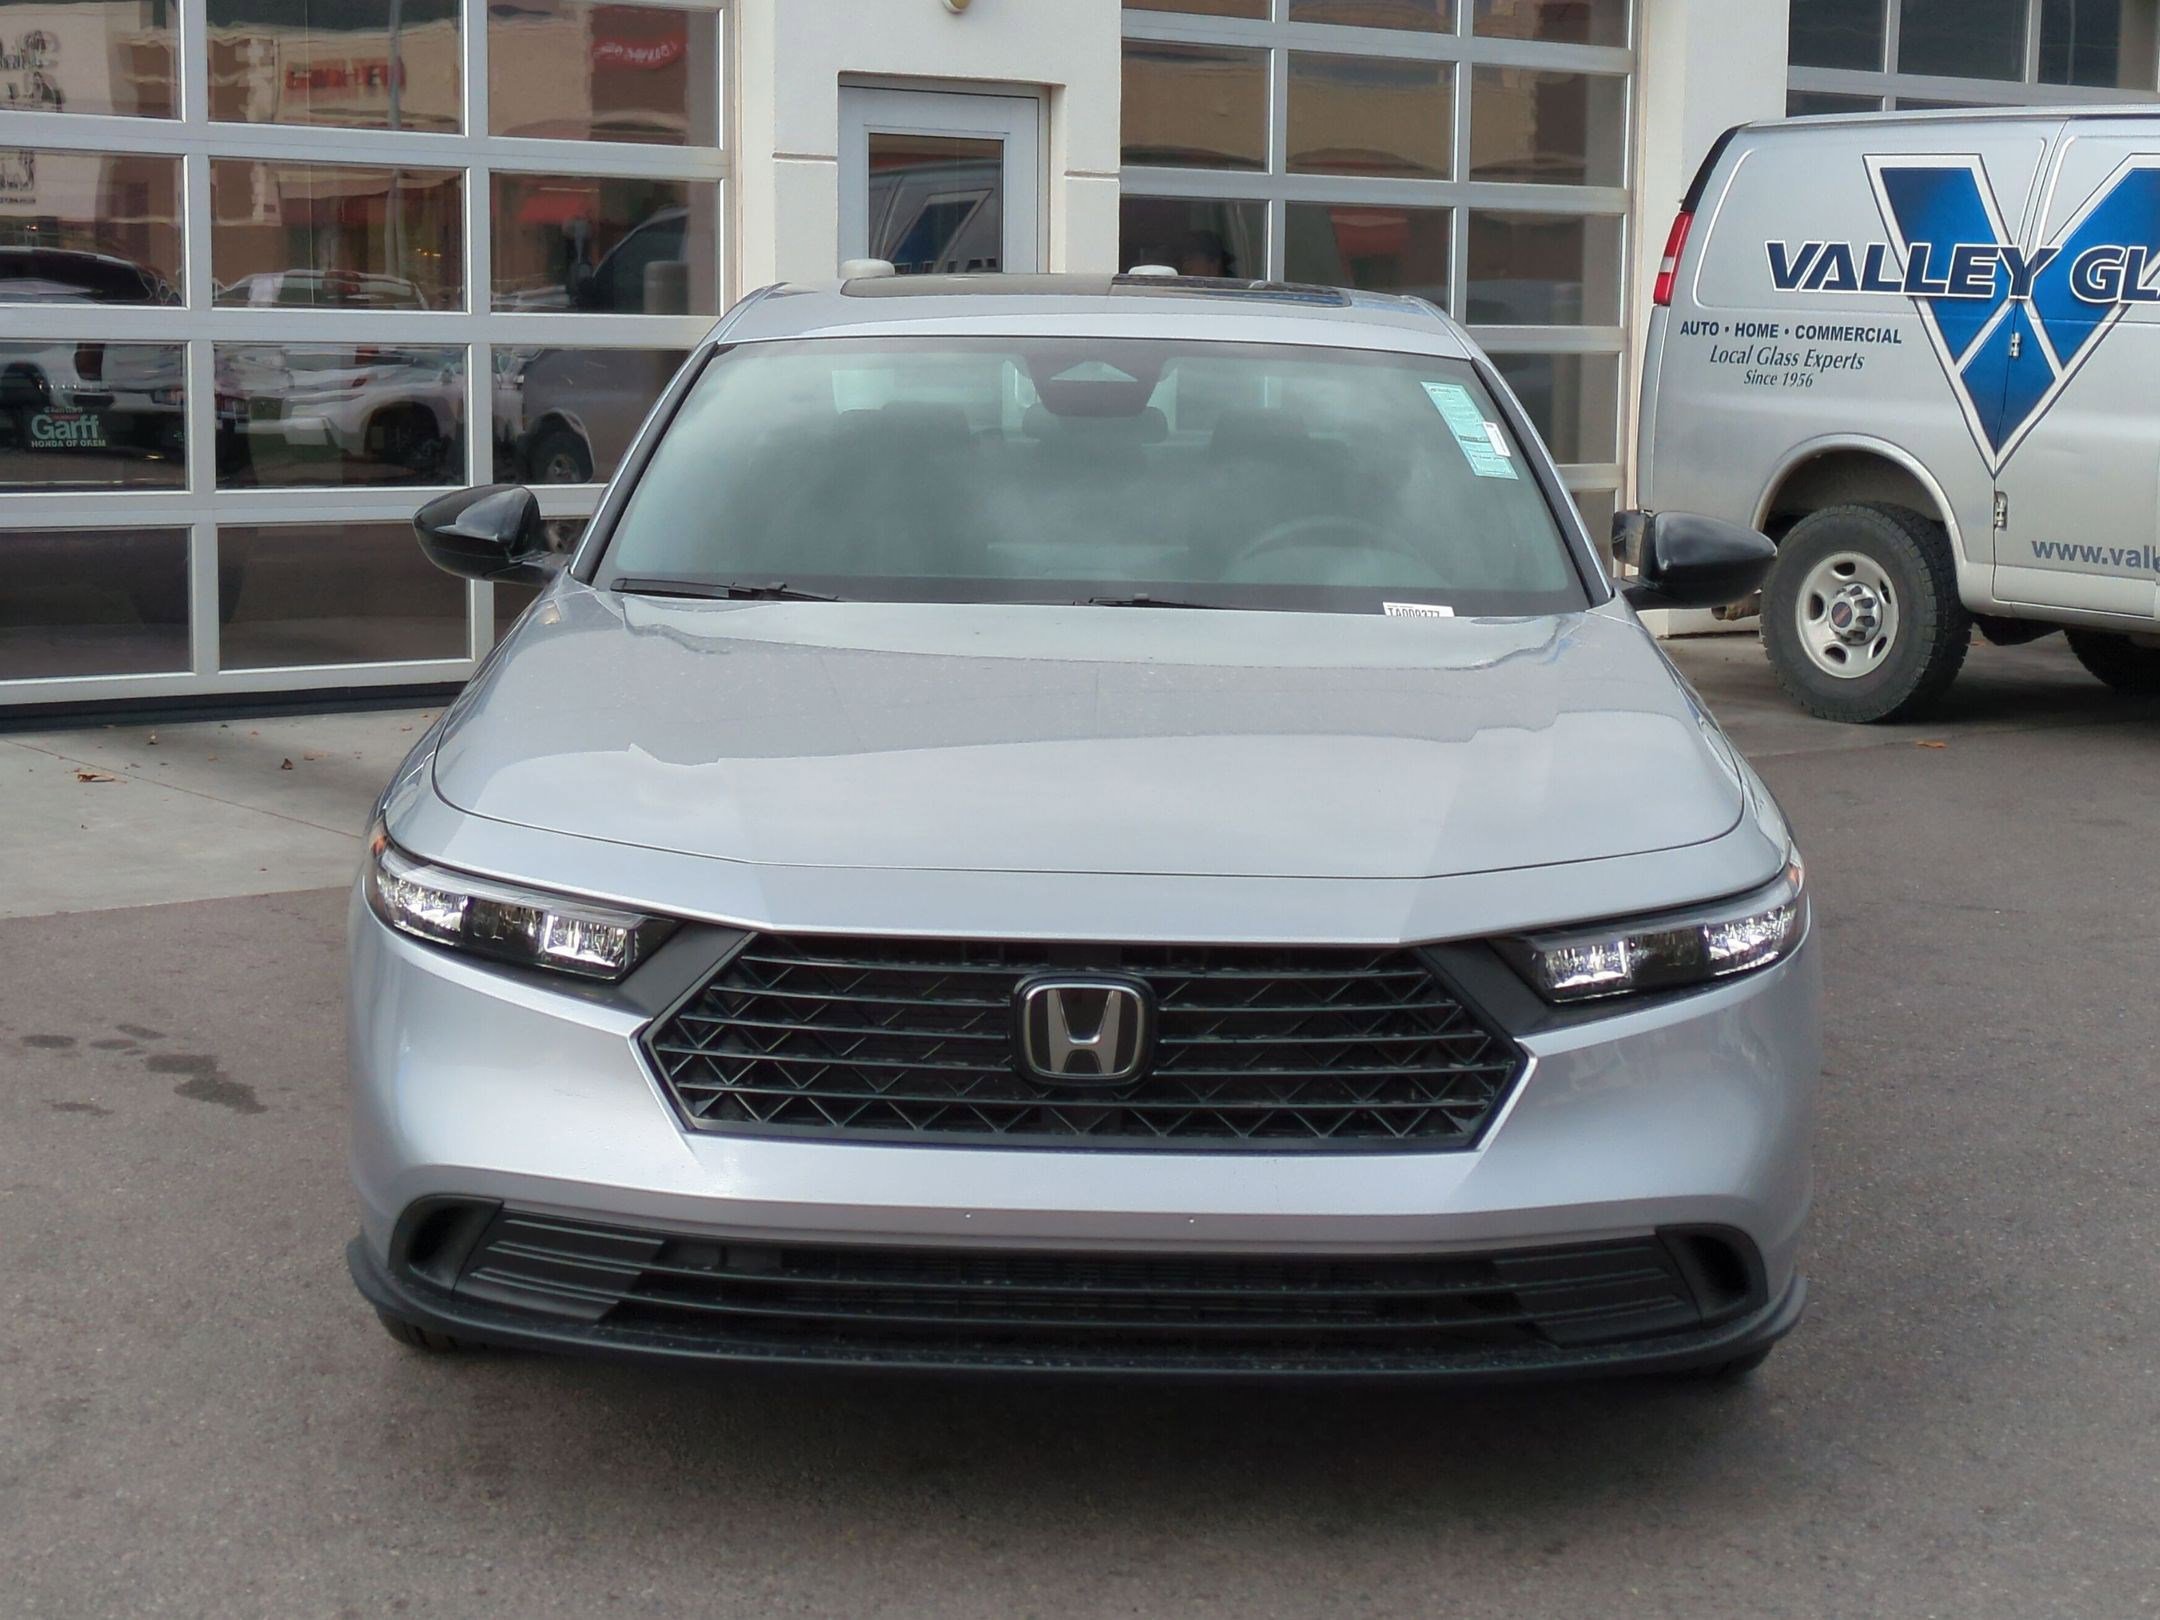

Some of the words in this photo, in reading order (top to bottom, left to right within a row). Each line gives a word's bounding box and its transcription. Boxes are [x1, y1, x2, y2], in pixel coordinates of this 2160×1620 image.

[1765, 241, 2062, 299] VALLEY
[2070, 245, 2160, 304] GL
[1680, 321, 1719, 336] AUTO
[1734, 322, 1779, 339] HOME
[1795, 325, 1902, 344] COMMERCIAL
[1710, 345, 1754, 365] Local
[1756, 346, 1800, 367] Glass
[1804, 349, 1865, 373] Experts
[1744, 370, 1778, 386] Since
[1782, 371, 1814, 388] 1956
[31, 414, 99, 440] Garff
